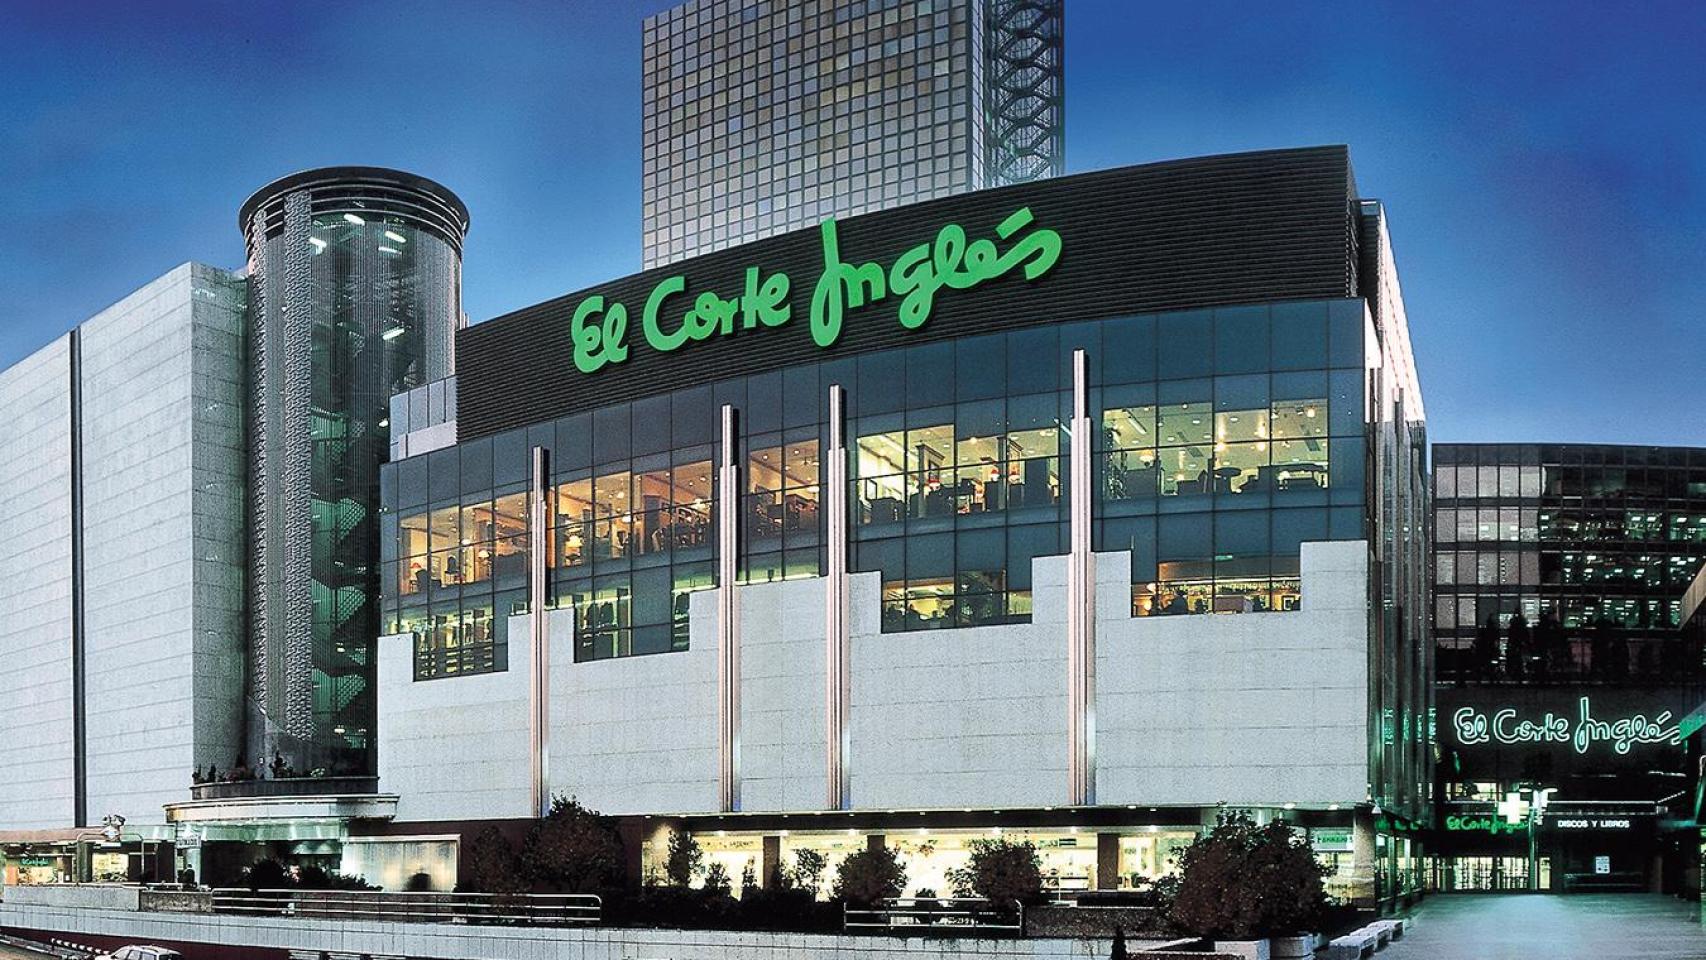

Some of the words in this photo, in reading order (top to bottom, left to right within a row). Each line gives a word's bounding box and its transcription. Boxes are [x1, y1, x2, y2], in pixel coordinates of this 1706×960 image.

[571, 295, 628, 374] El
[642, 267, 791, 352] Corte
[809, 206, 1062, 348] Inglés
[1454, 707, 1489, 745] El
[1494, 709, 1570, 744] Corte
[1557, 820, 1589, 828] DISCOS
[1591, 820, 1598, 828] Y
[1600, 820, 1630, 828] LIBROS
